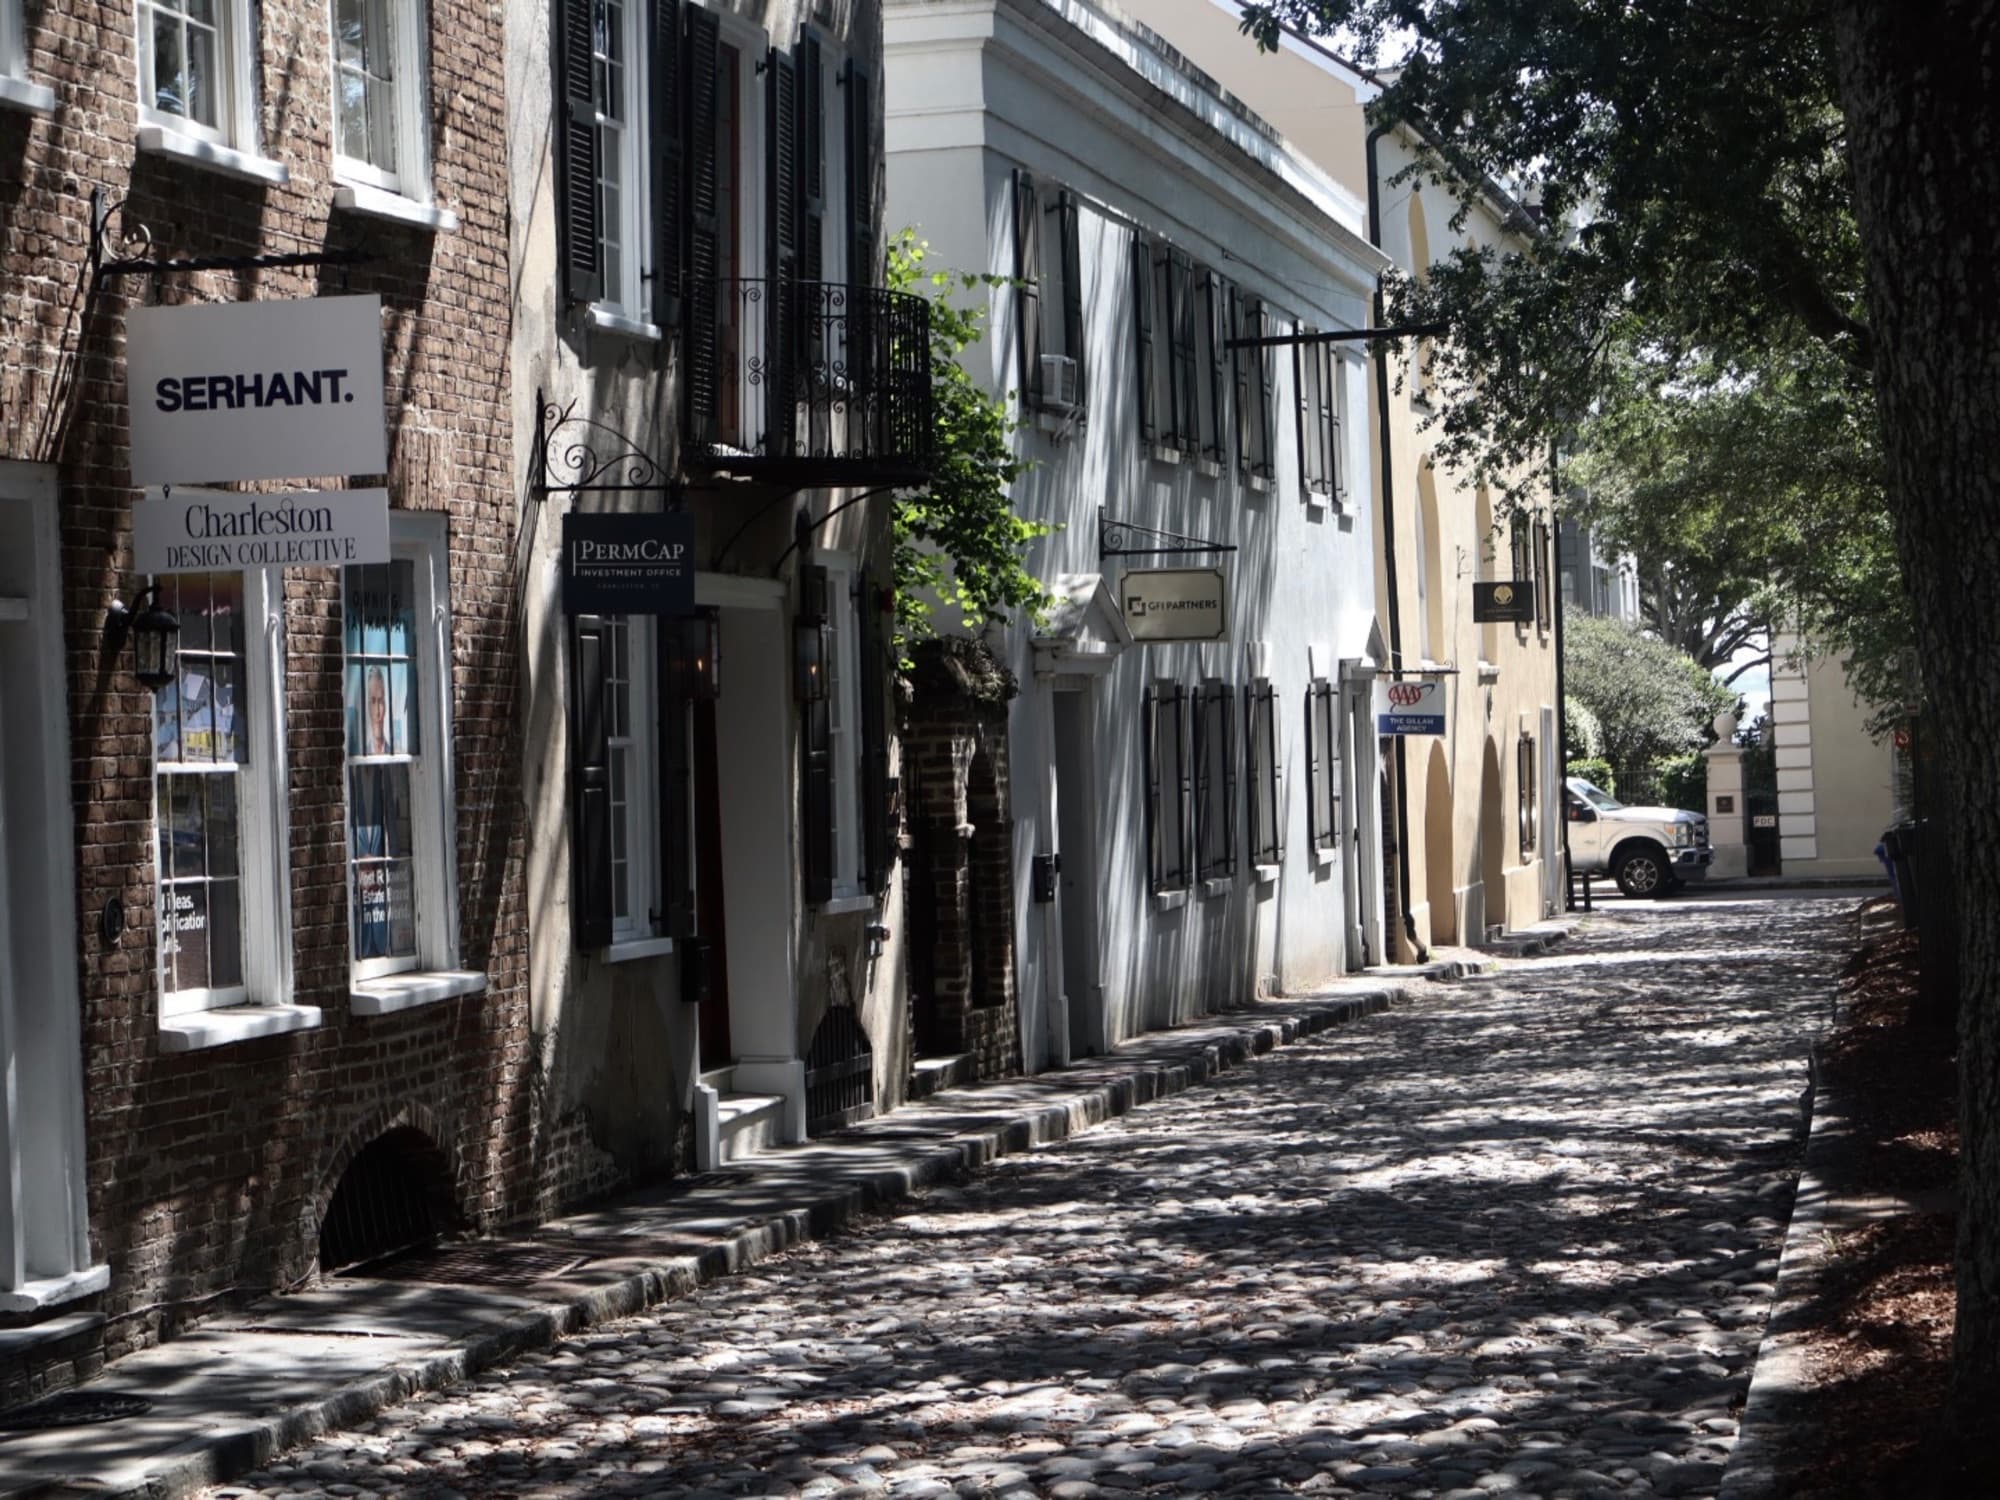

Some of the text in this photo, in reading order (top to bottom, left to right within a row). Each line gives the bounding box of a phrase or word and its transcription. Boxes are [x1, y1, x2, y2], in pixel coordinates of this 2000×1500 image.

[156, 369, 354, 412] SERHANT.
[185, 498, 333, 539] Charleston
[167, 537, 356, 569] DESIGN COLLECTIVE
[580, 568, 681, 577] INVESTMENT OFFICE
[1148, 600, 1217, 610] GFI PARTNERS
[1389, 683, 1421, 706] AAA
[1389, 717, 1405, 725] THE
[372, 906, 385, 923] the
